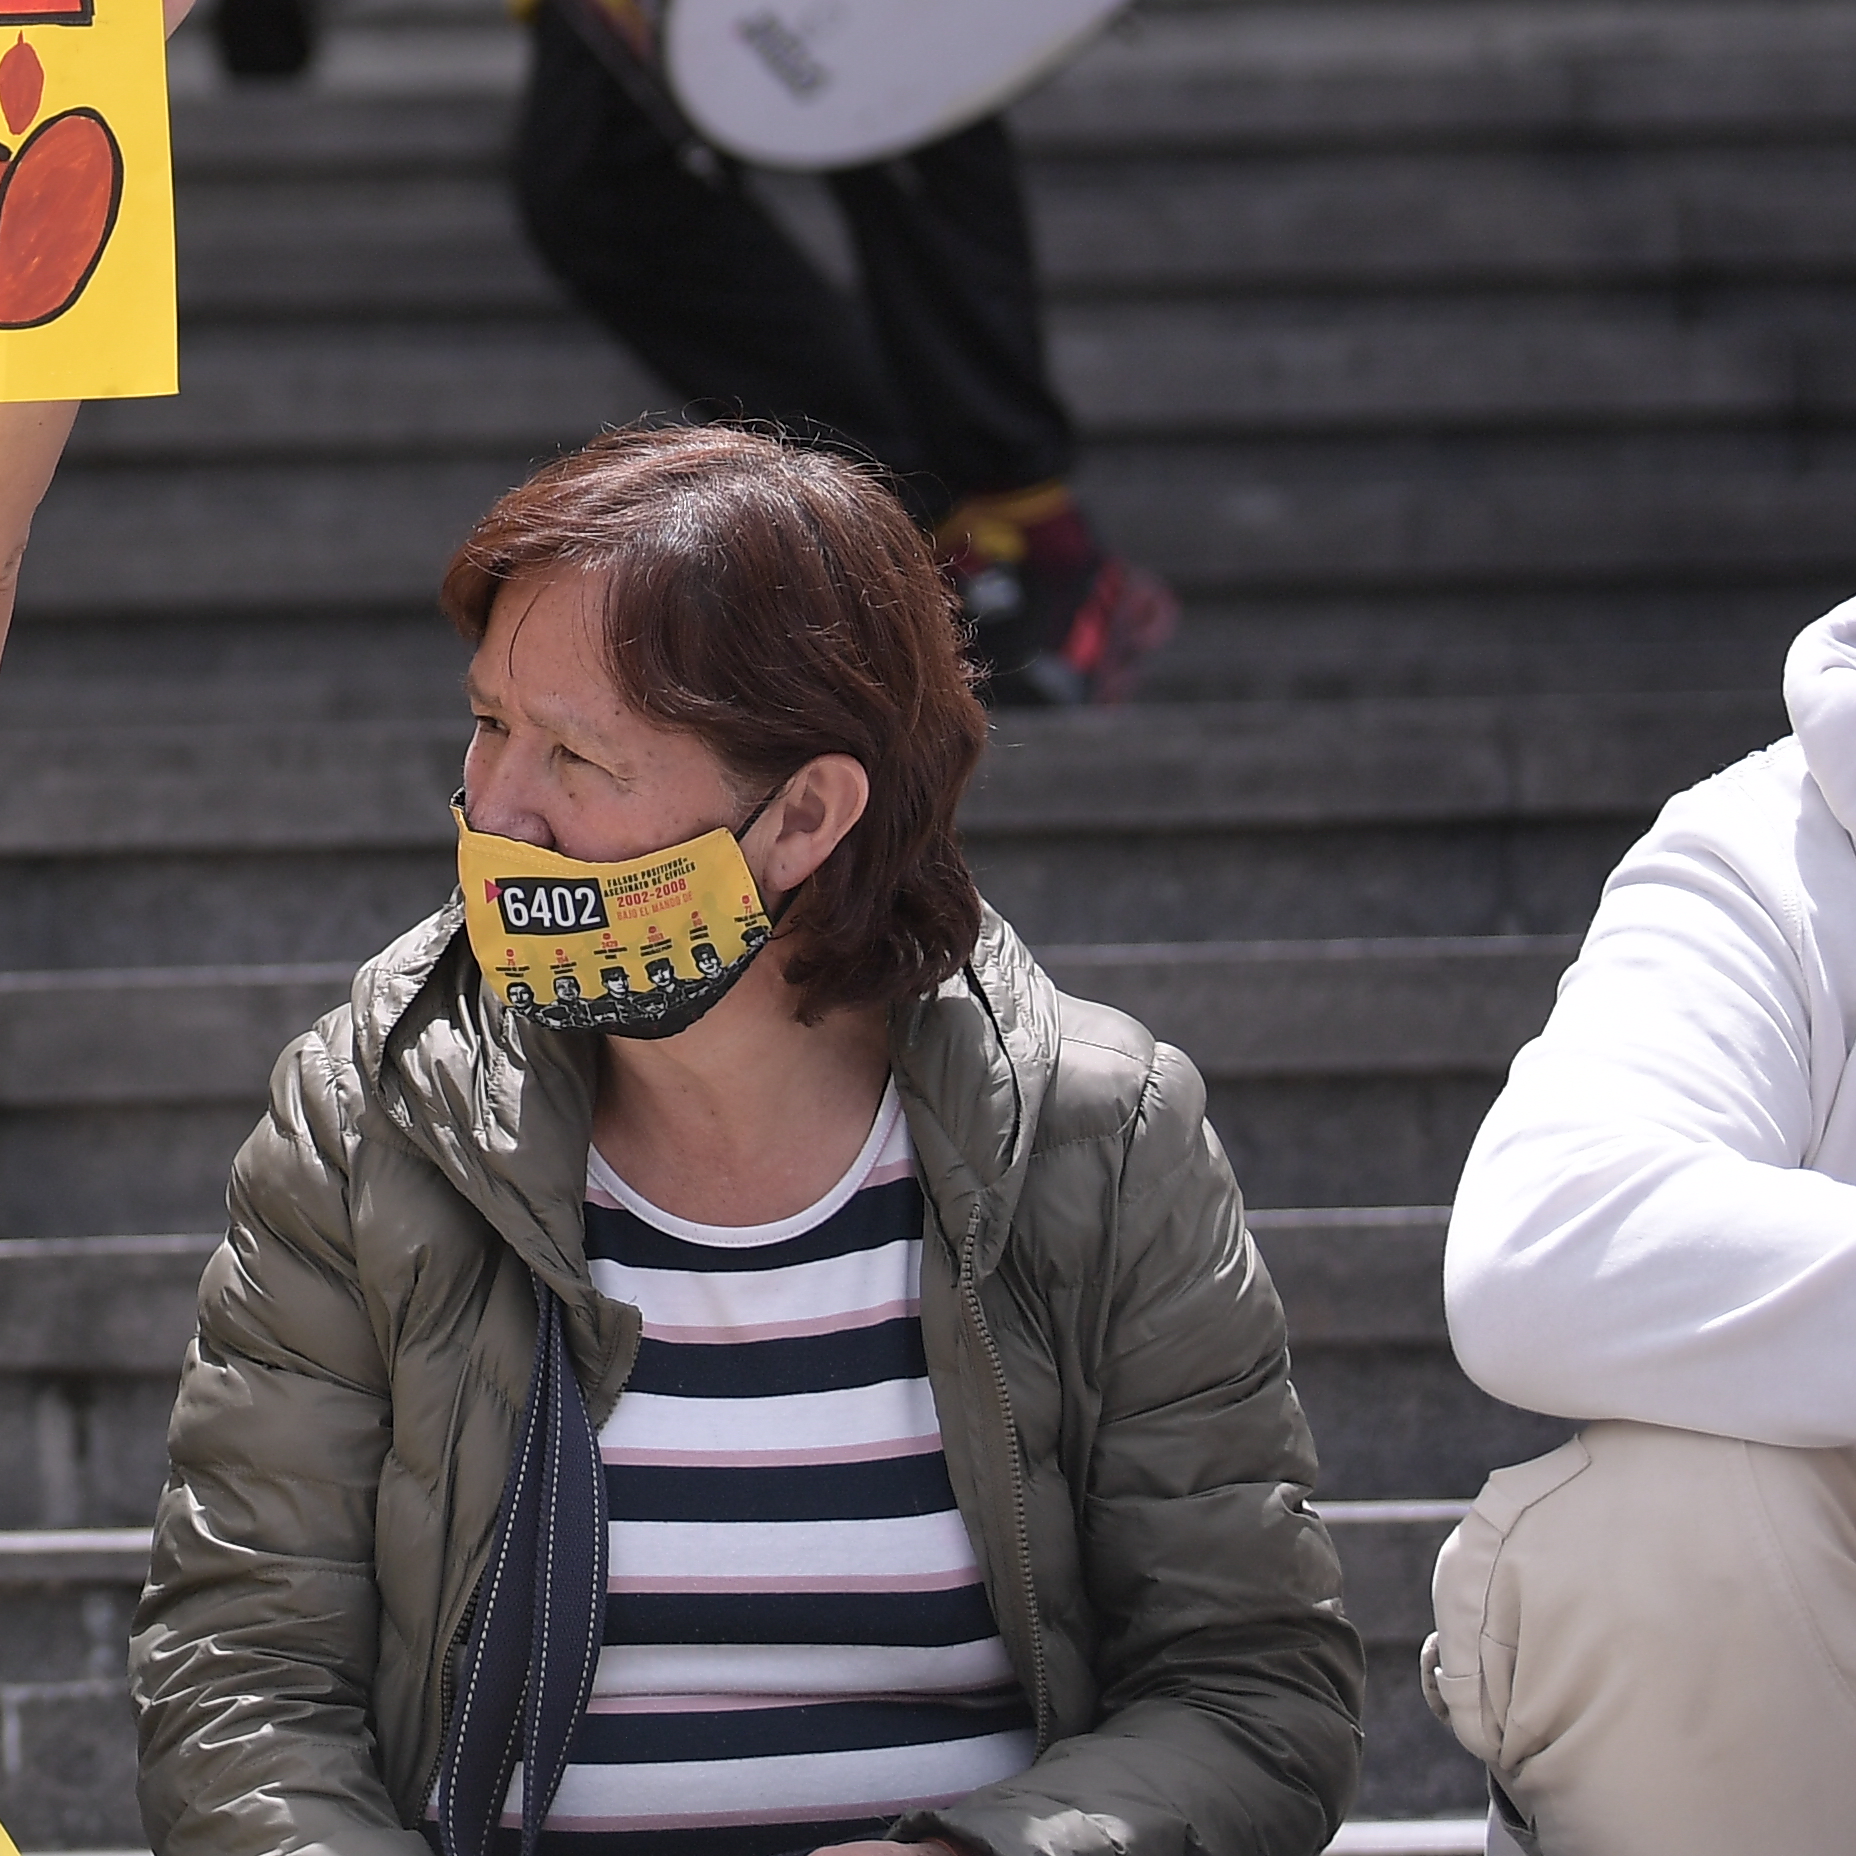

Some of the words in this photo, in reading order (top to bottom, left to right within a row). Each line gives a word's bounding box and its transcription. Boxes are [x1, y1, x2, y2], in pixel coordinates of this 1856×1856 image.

[604, 880, 649, 898] ASESINATO
[652, 877, 662, 886] DE
[664, 862, 696, 881] CIVILES
[607, 873, 639, 888] FALSOS
[616, 878, 687, 907] 2002-2008
[503, 887, 601, 928] 6402
[617, 908, 638, 921] BAJO
[639, 906, 649, 917] EL
[652, 895, 681, 913] MANDO
[682, 891, 693, 902] DE
